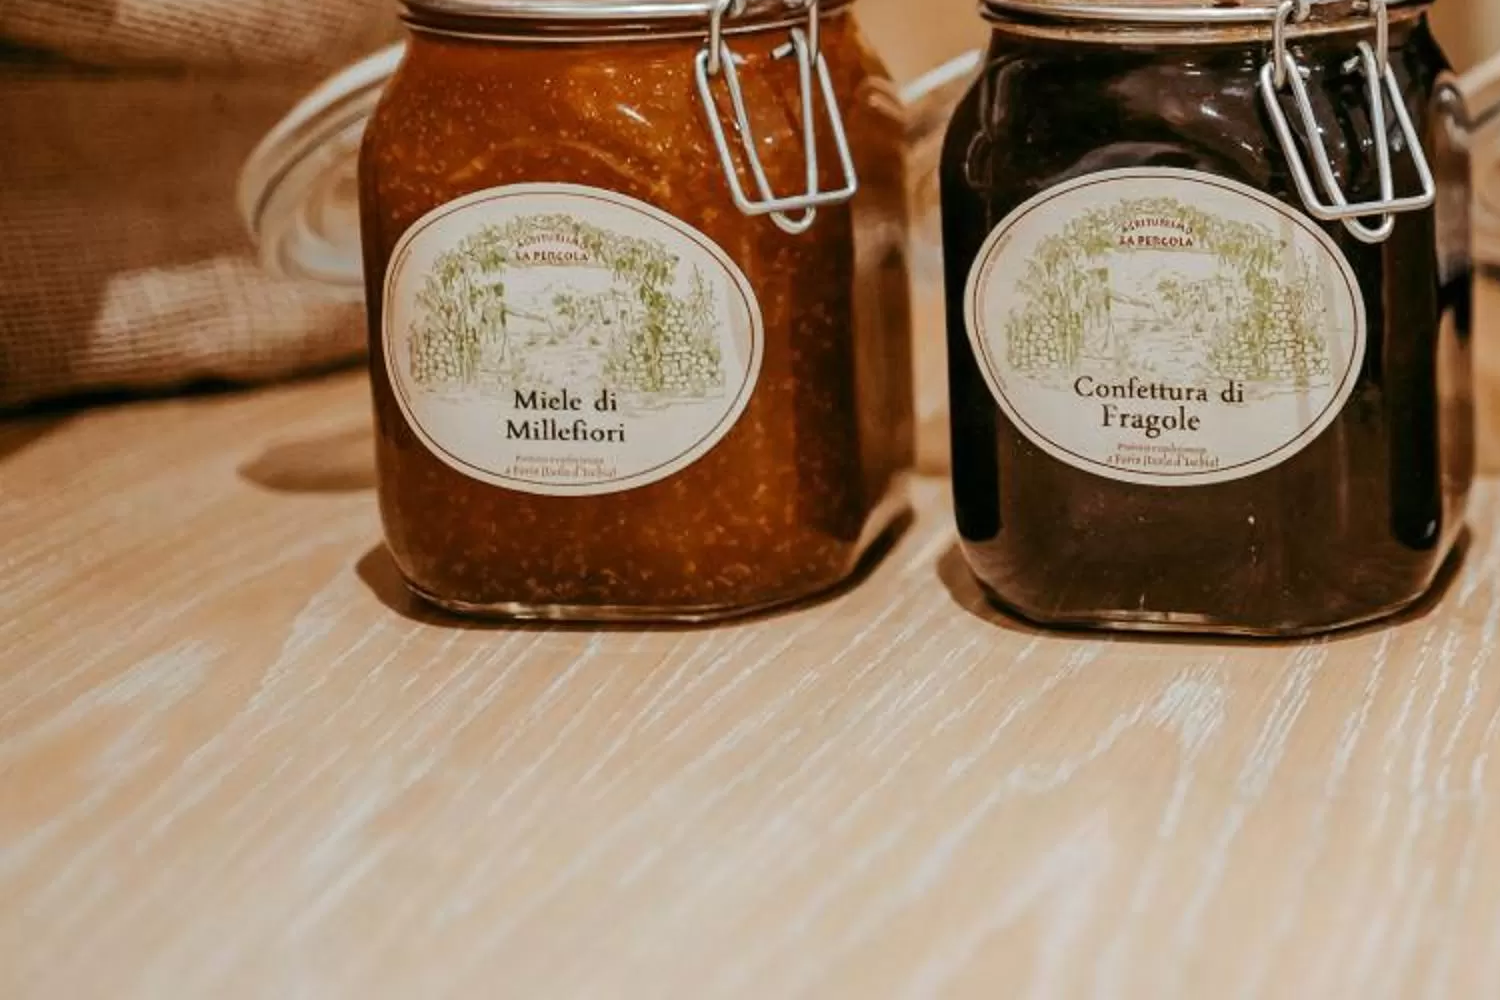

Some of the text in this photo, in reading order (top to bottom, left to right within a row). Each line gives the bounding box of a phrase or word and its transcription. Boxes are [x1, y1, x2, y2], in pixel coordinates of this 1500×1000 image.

[1119, 236, 1194, 247] LA PERGOLA
[515, 250, 530, 262] LA
[513, 388, 618, 413] Miele di
[1073, 375, 1245, 404] Confettura di
[505, 418, 627, 444] Millefiori
[1101, 404, 1201, 439] Fragole
